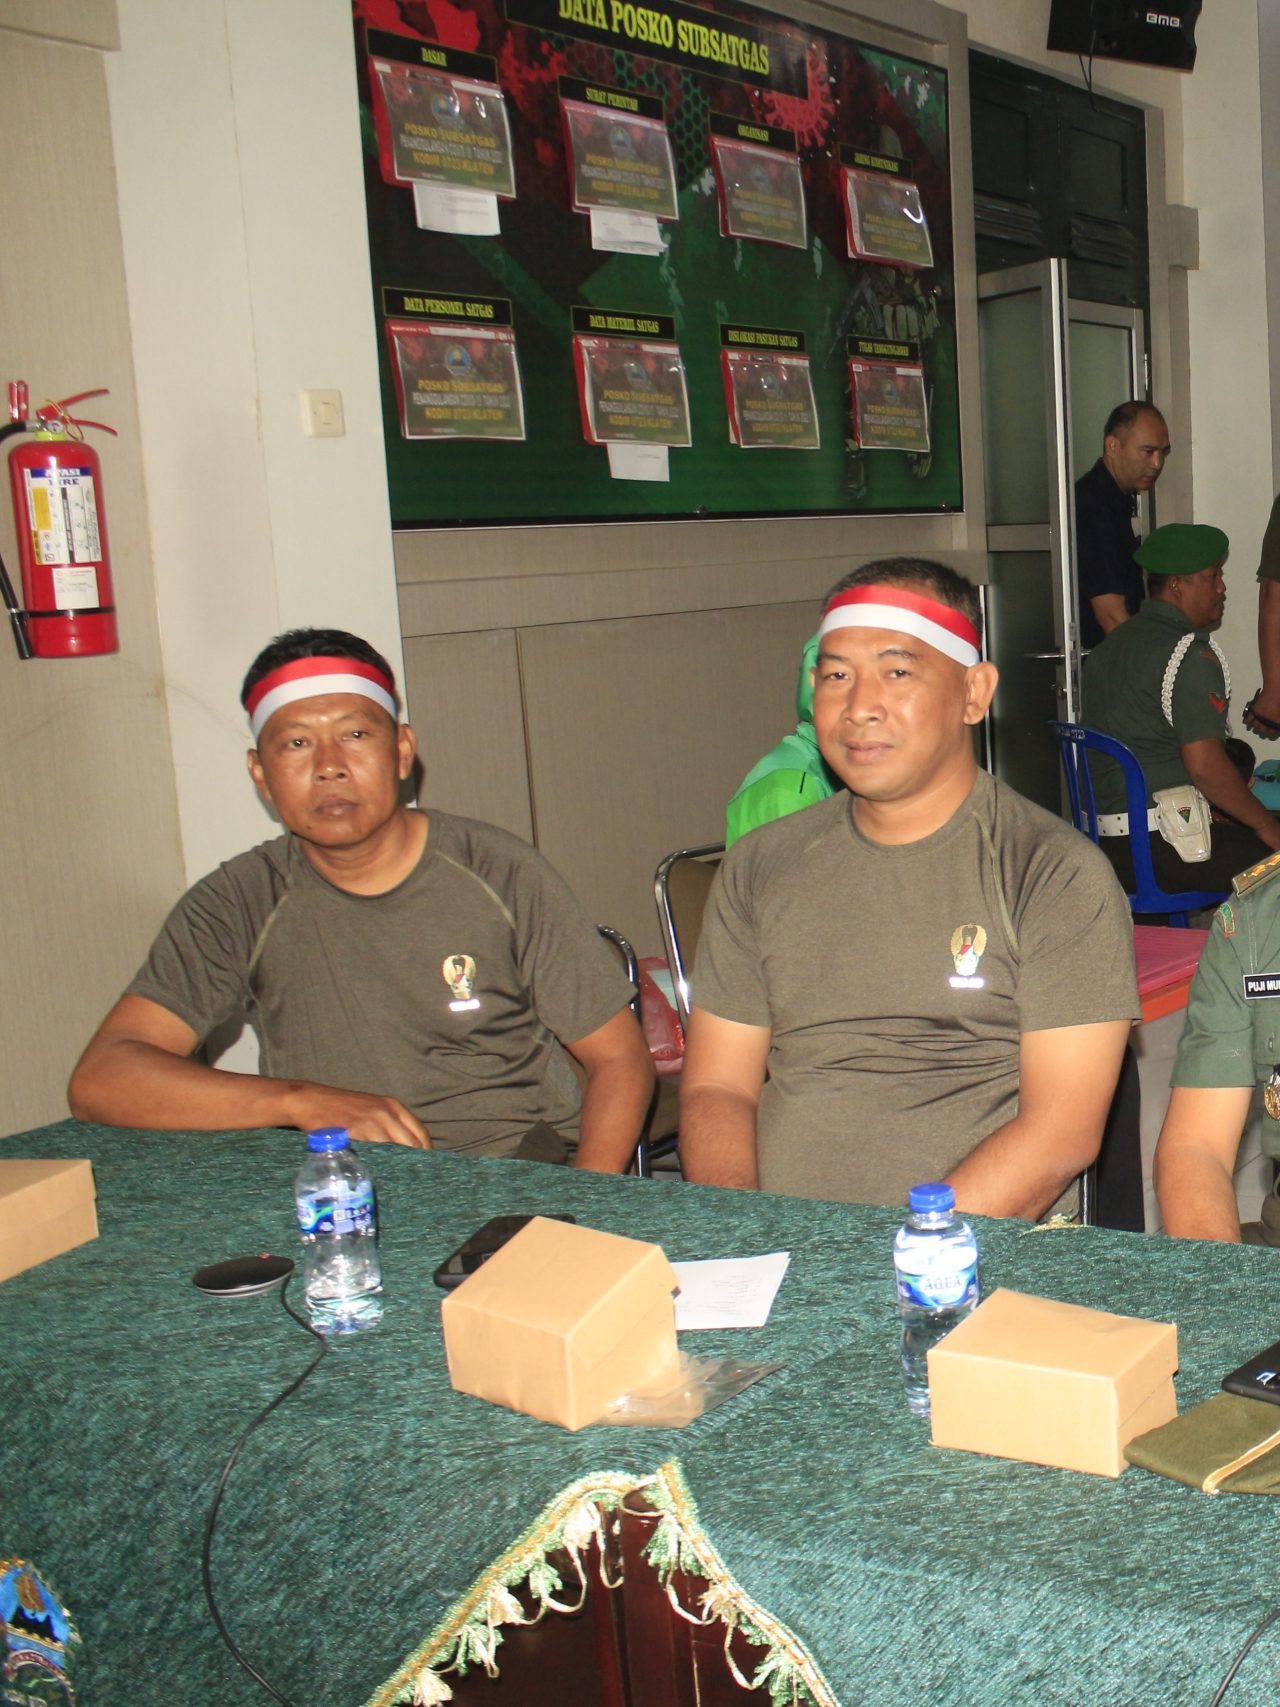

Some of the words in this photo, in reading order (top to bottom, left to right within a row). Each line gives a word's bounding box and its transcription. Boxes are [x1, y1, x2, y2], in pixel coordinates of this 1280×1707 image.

[559, 0, 608, 30] DATA
[612, 0, 674, 48] POSKO
[677, 18, 769, 76] SUBSATGAS
[424, 298, 465, 316] PERSONEL
[465, 302, 494, 318] SATGAS
[1247, 981, 1266, 992] PUJI
[923, 1276, 962, 1292] AQUA
